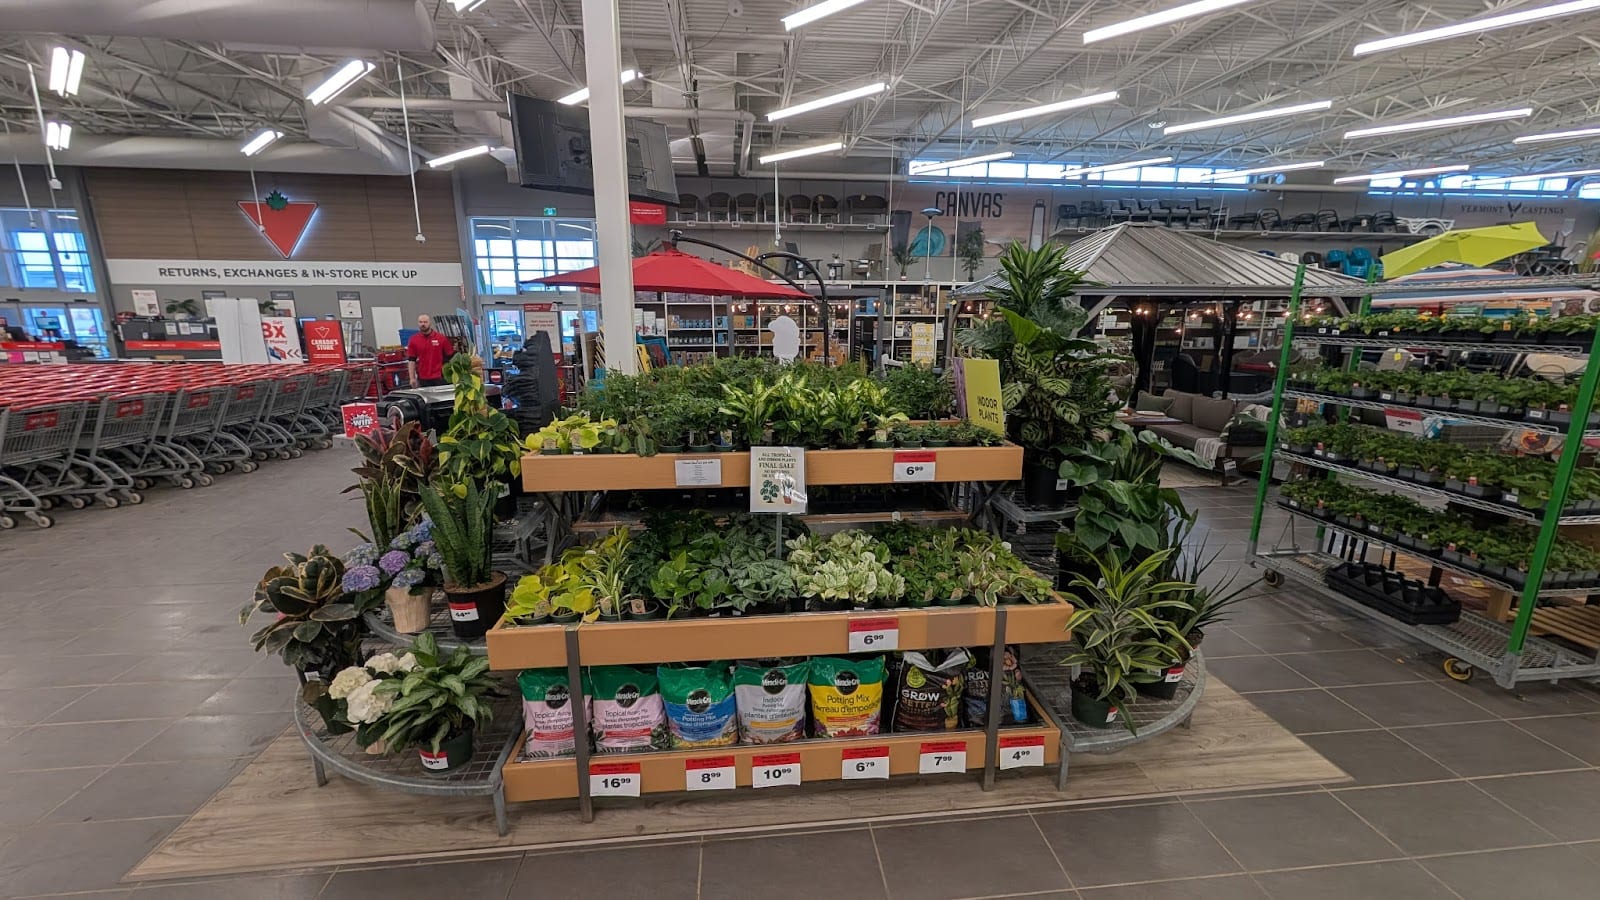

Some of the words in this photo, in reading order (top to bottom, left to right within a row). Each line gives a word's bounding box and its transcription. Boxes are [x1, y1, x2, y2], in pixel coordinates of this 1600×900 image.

[935, 191, 1003, 218] CANVAS
[1461, 204, 1504, 214] VERMONT
[1521, 205, 1565, 215] CASTINGS
[158, 267, 221, 279] RETURNS,
[223, 268, 298, 278] EXCHANGES
[301, 269, 309, 278] &
[312, 269, 369, 279] IN-STORE
[371, 270, 399, 279] PICK
[402, 270, 417, 279] UP
[977, 395, 998, 410] INDOOR
[979, 408, 999, 424] PLANTS
[827, 695, 855, 706] Potting
[856, 694, 870, 702] Mix
[605, 710, 627, 718] Tropical
